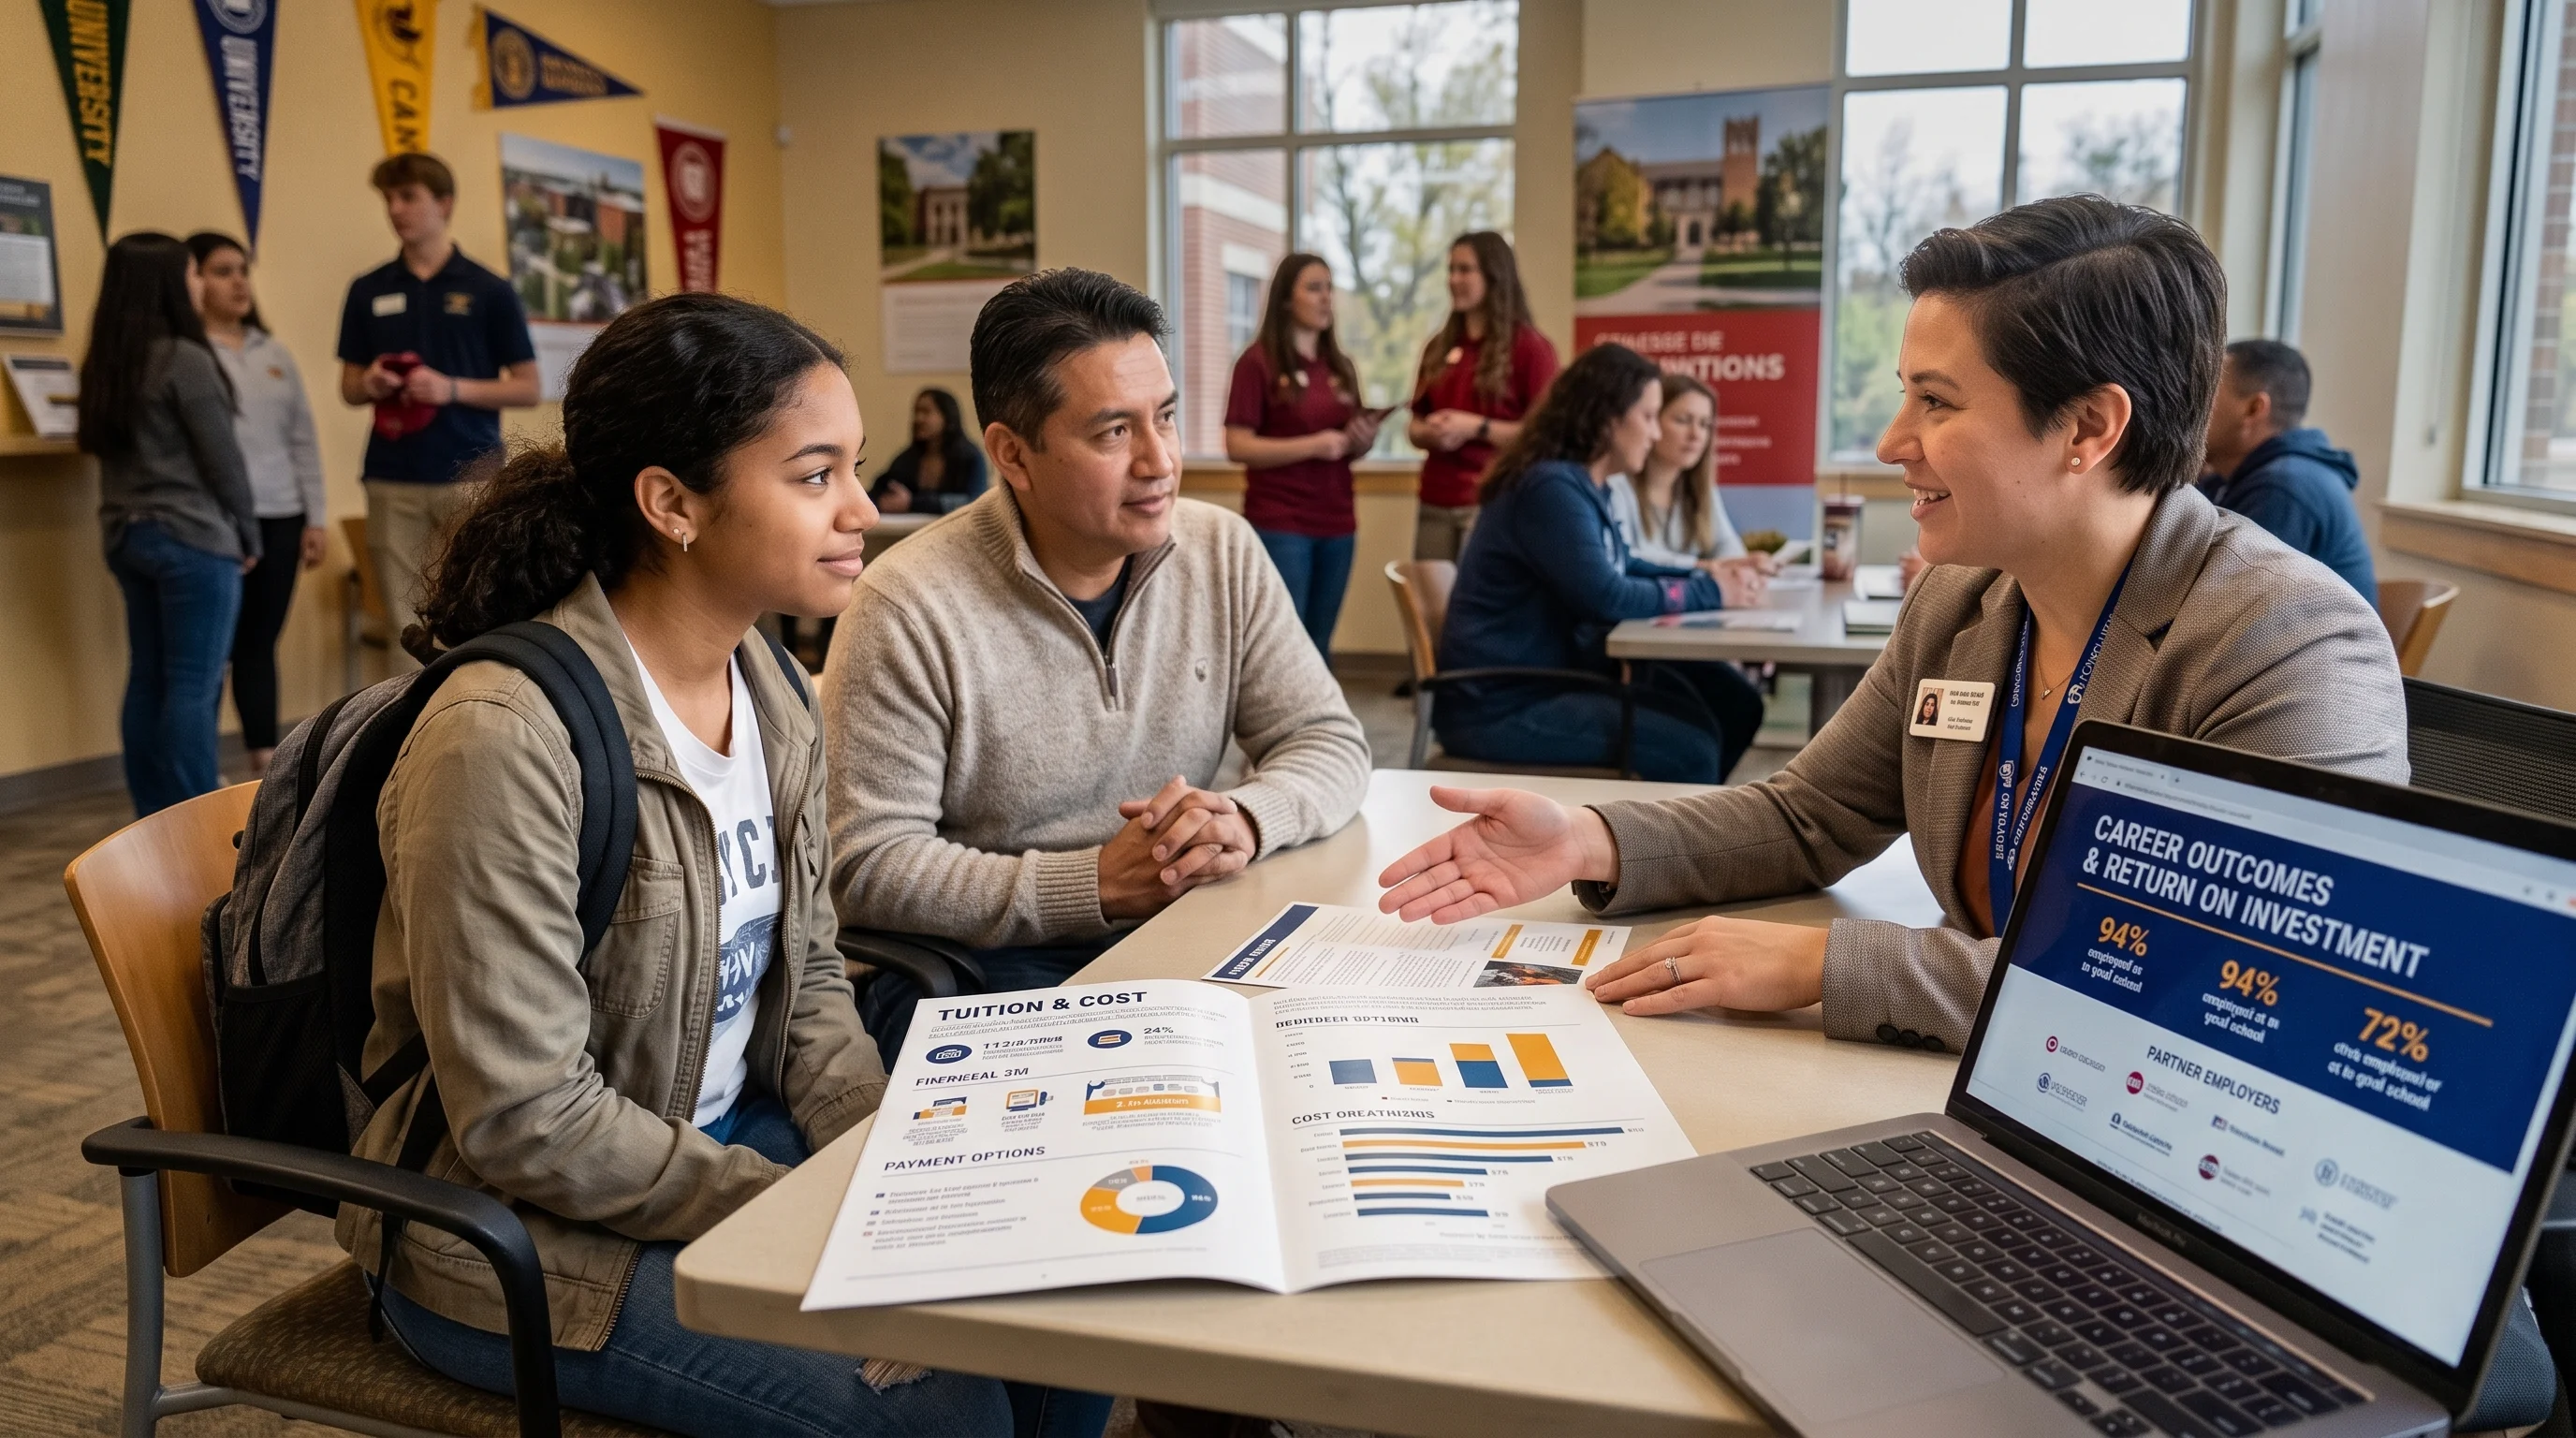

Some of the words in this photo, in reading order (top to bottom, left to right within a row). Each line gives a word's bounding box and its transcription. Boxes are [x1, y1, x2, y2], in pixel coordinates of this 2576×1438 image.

[220, 35, 261, 183] UNIVERSITY
[2095, 814, 2184, 863] CAREER
[2187, 841, 2334, 907] OUTCOMES
[2083, 846, 2100, 874] &
[2103, 853, 2198, 907] RETURN
[2200, 884, 2239, 919] ON
[2240, 895, 2431, 979] INVESTMENT
[2098, 917, 2149, 957] 94%
[938, 999, 1044, 1021] TUITION
[1052, 997, 1071, 1011] &
[1078, 991, 1148, 1008] COST
[2219, 959, 2280, 1007] 94%
[2358, 1006, 2430, 1064] 72%
[2146, 1045, 2203, 1080] PARTNER
[2203, 1070, 2281, 1115] EMPLOYERS
[1292, 1111, 1331, 1124] COST
[885, 1155, 966, 1171] PAYMENT
[972, 1146, 1046, 1163] OPTIONS
